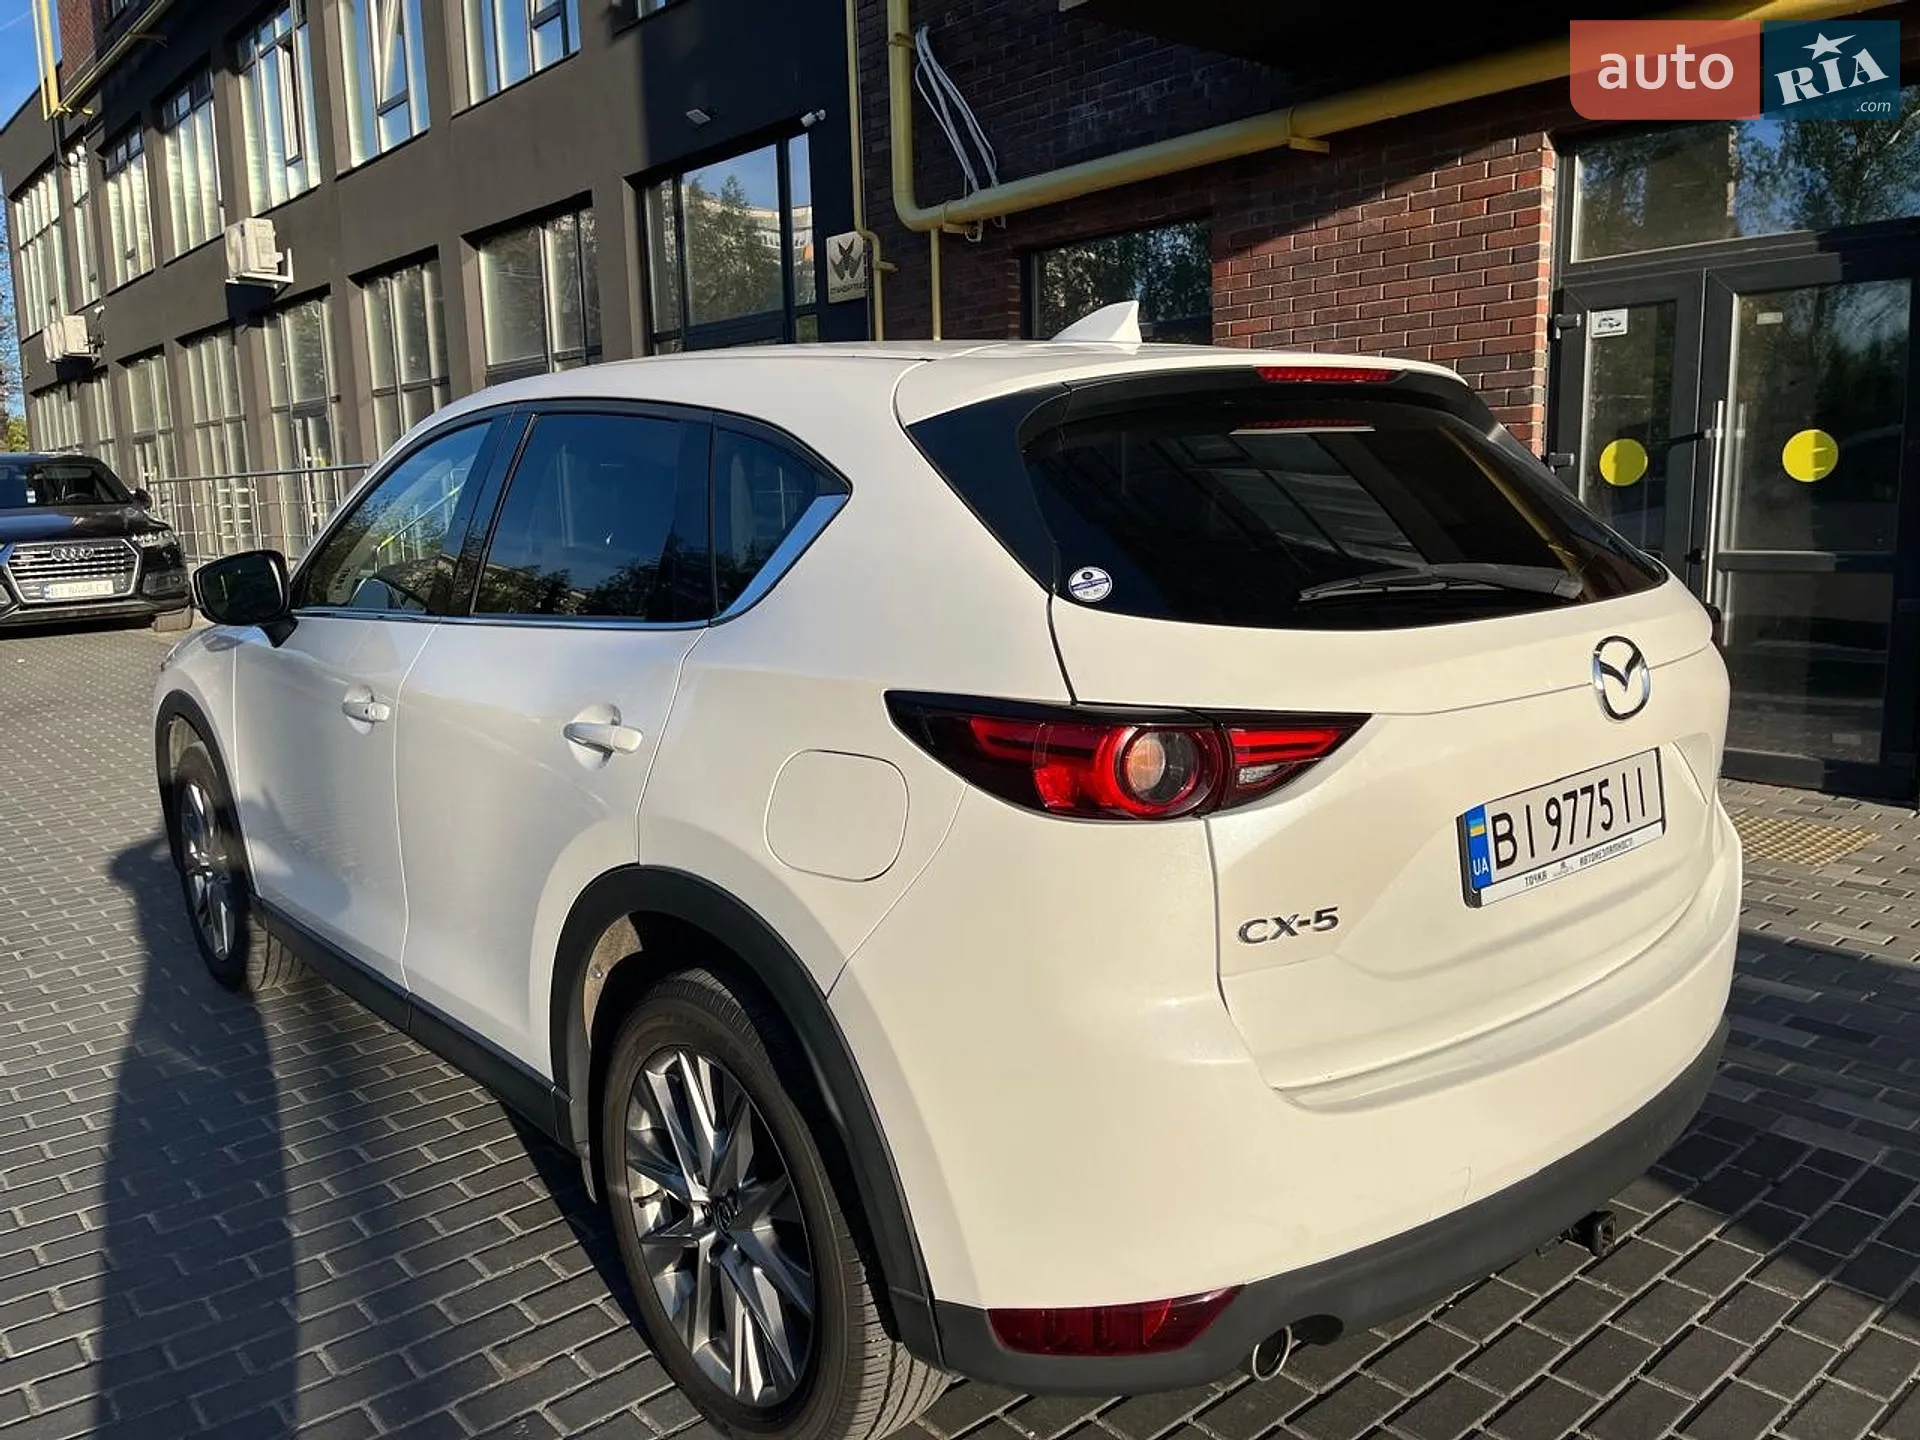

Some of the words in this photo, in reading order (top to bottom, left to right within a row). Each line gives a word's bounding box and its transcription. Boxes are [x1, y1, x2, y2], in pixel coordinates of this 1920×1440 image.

[1491, 804, 1536, 870] BI
[1545, 778, 1614, 852] 9775
[1473, 857, 1490, 876] UA
[1238, 906, 1339, 944] CX-5
